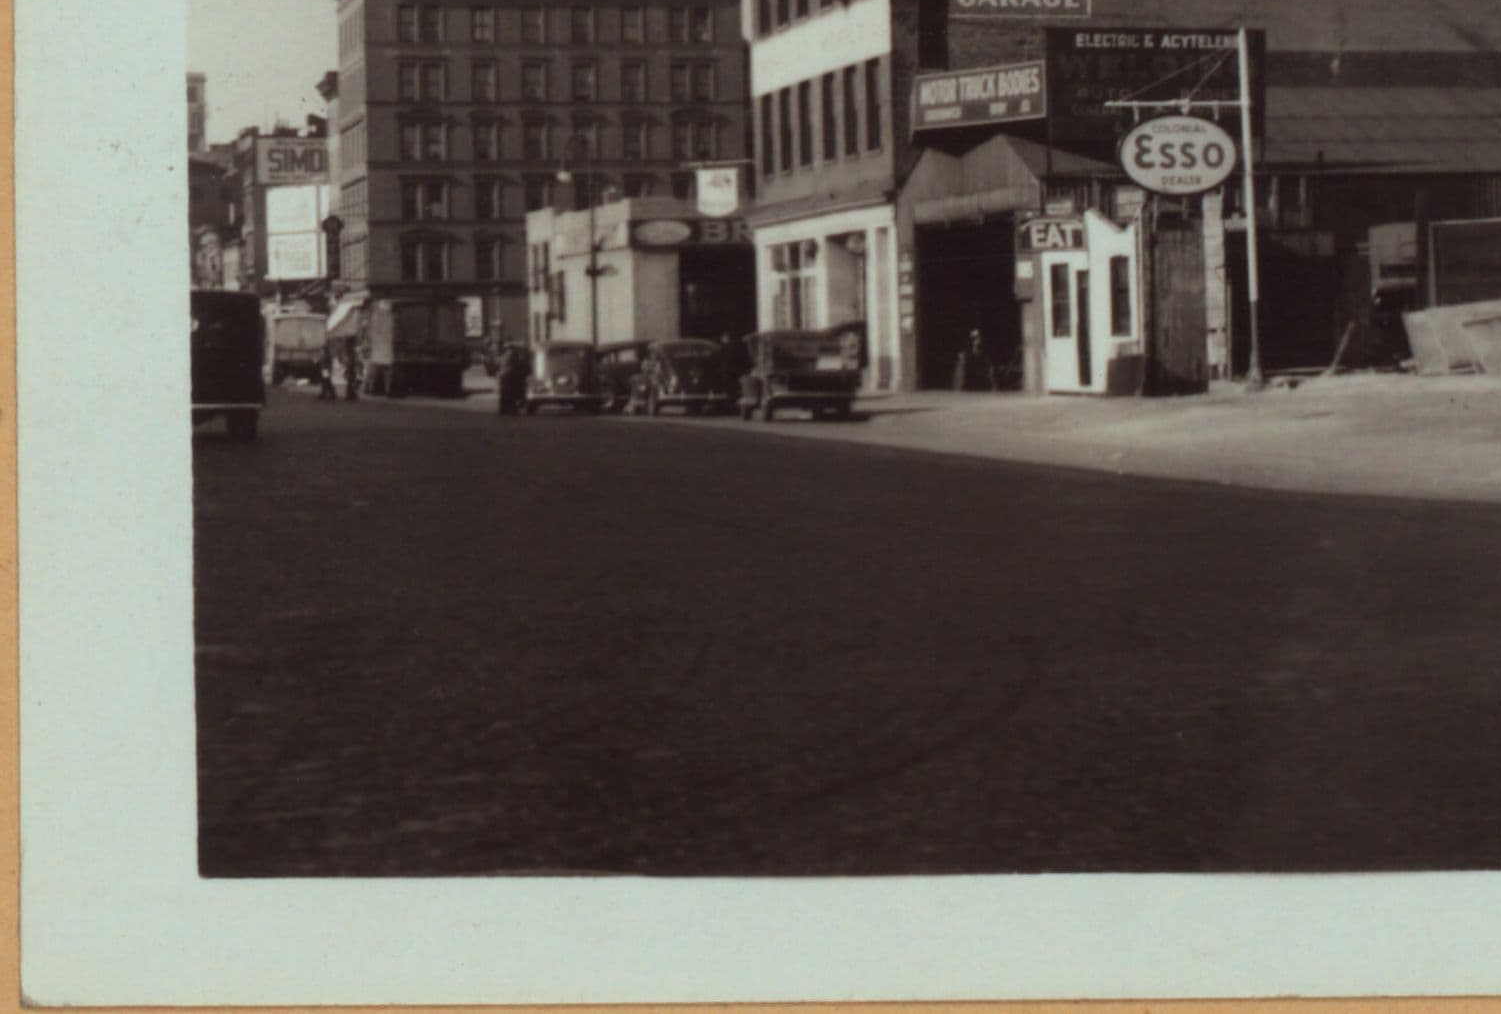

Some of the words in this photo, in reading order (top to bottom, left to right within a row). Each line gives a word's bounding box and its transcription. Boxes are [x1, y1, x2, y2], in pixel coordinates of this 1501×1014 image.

[1074, 33, 1140, 48] ELECTRIC
[919, 78, 957, 106] MOTOR
[959, 73, 996, 101] TRUCK
[998, 67, 1041, 97] BODIES
[1151, 123, 1207, 134] COLONIAL
[1160, 175, 1202, 187] DEALER
[1030, 222, 1080, 248] EAT
